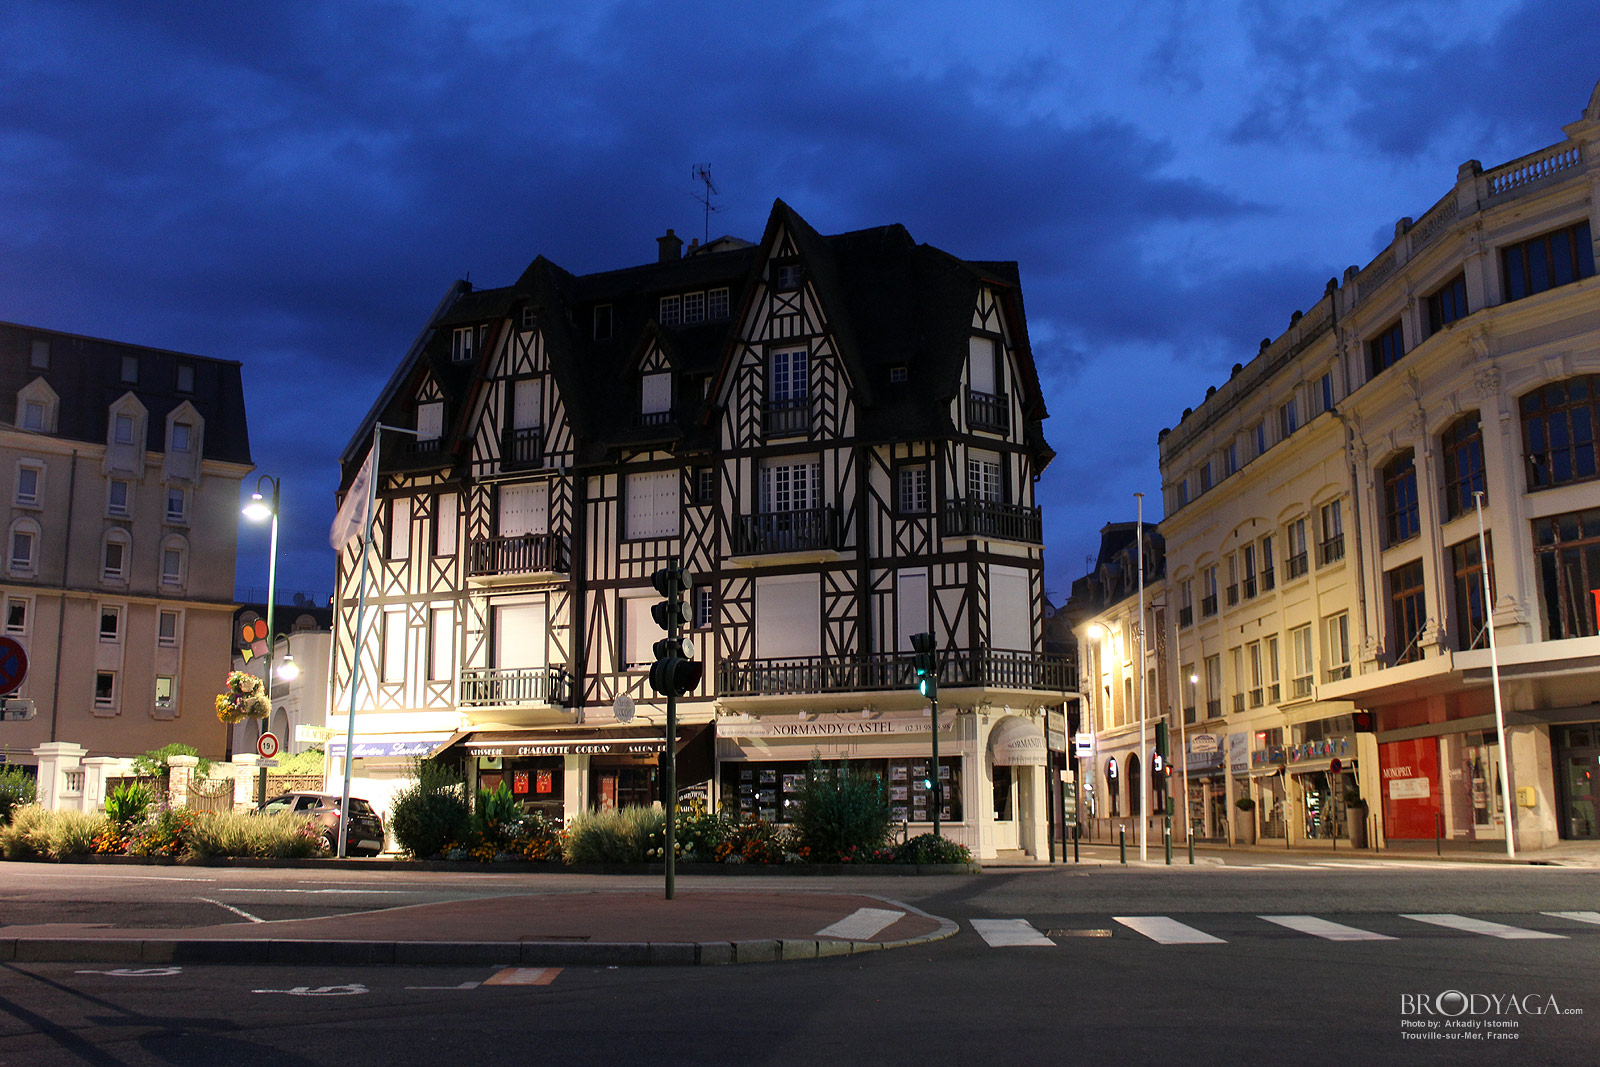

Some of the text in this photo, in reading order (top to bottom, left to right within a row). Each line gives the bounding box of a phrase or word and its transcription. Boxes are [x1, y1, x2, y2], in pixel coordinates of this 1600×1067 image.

[773, 723, 844, 735] NORMANDY
[847, 722, 895, 733] CASTEL
[905, 724, 913, 732] 02
[518, 746, 570, 755] CHARLOTTE
[575, 745, 611, 754] CORDAY
[628, 745, 654, 753] SALON
[1383, 766, 1413, 778] MONOPRIX
